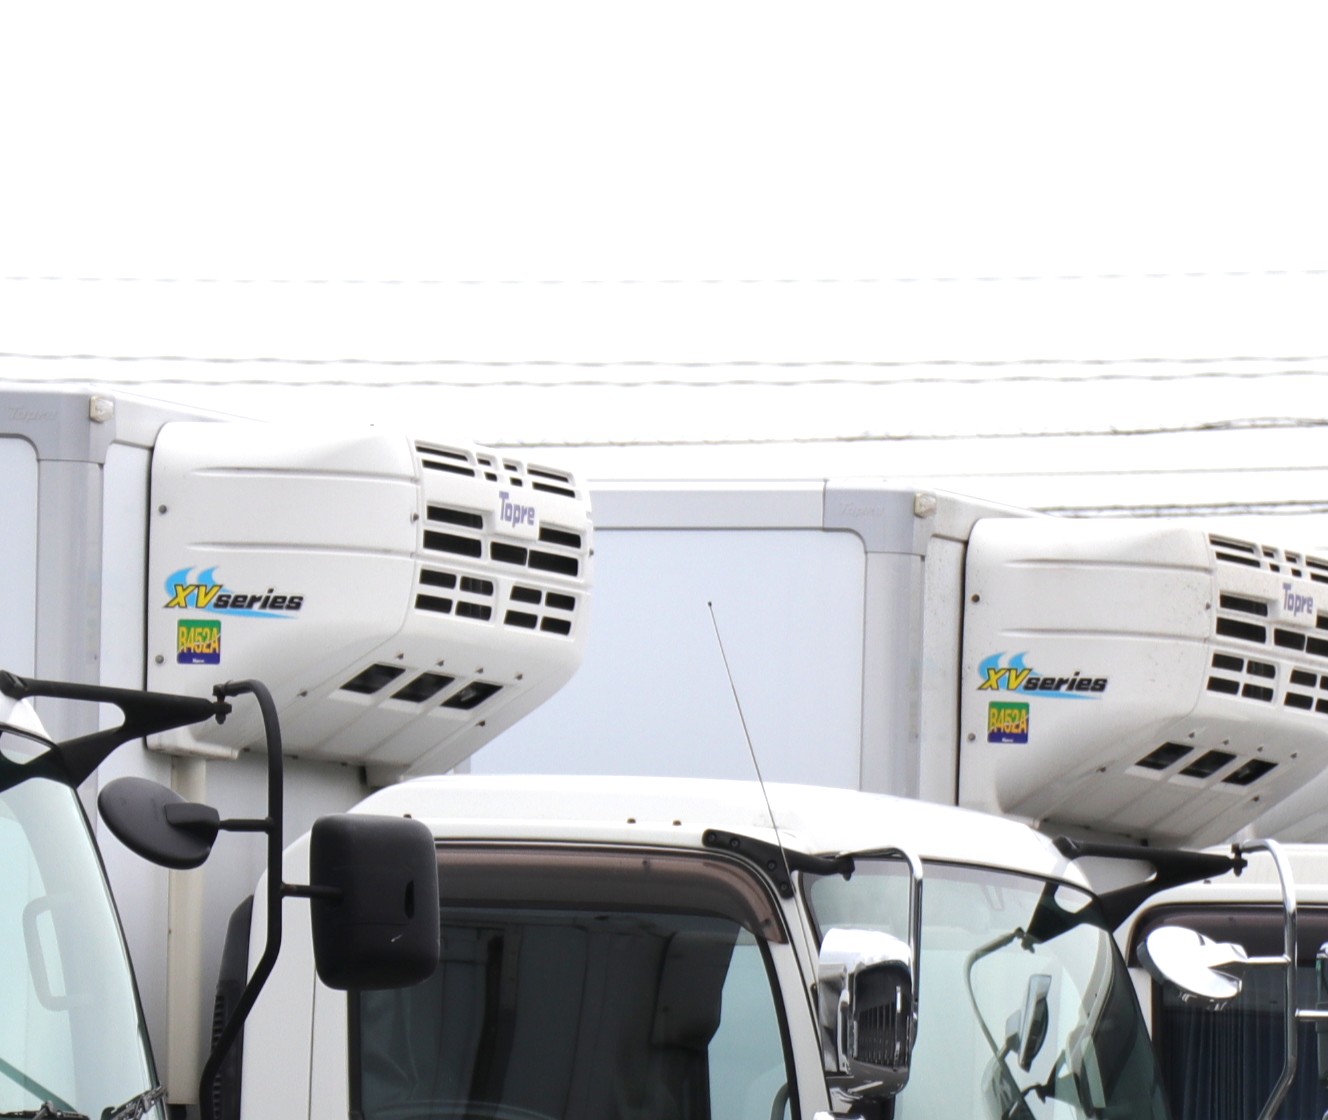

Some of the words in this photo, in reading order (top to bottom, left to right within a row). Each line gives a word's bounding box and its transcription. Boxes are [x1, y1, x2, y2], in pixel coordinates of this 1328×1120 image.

[499, 490, 535, 528] Topre
[1282, 582, 1314, 617] Topre
[178, 626, 221, 654] R452A
[987, 708, 1028, 734] R452A
